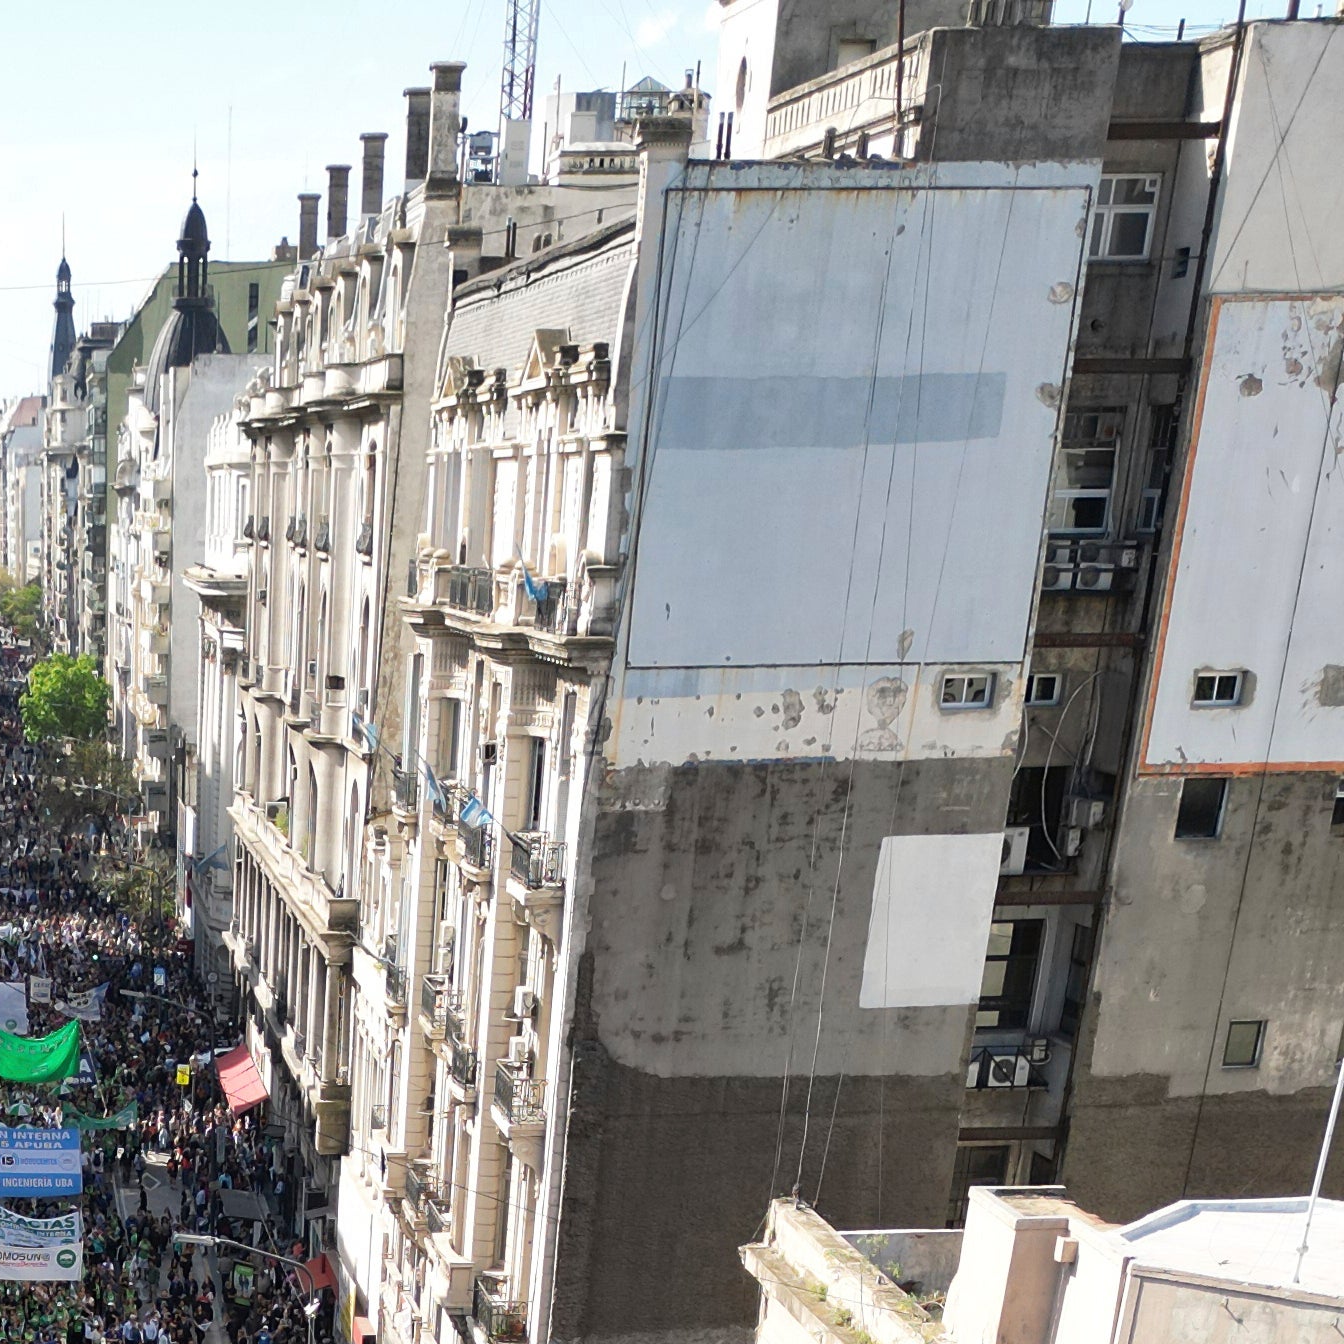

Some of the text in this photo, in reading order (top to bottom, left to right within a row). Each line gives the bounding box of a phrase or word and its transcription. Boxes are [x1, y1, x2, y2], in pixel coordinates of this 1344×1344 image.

[13, 1129, 71, 1140] INTERNA
[15, 1141, 63, 1149] APUBA
[56, 1177, 73, 1187] UBA
